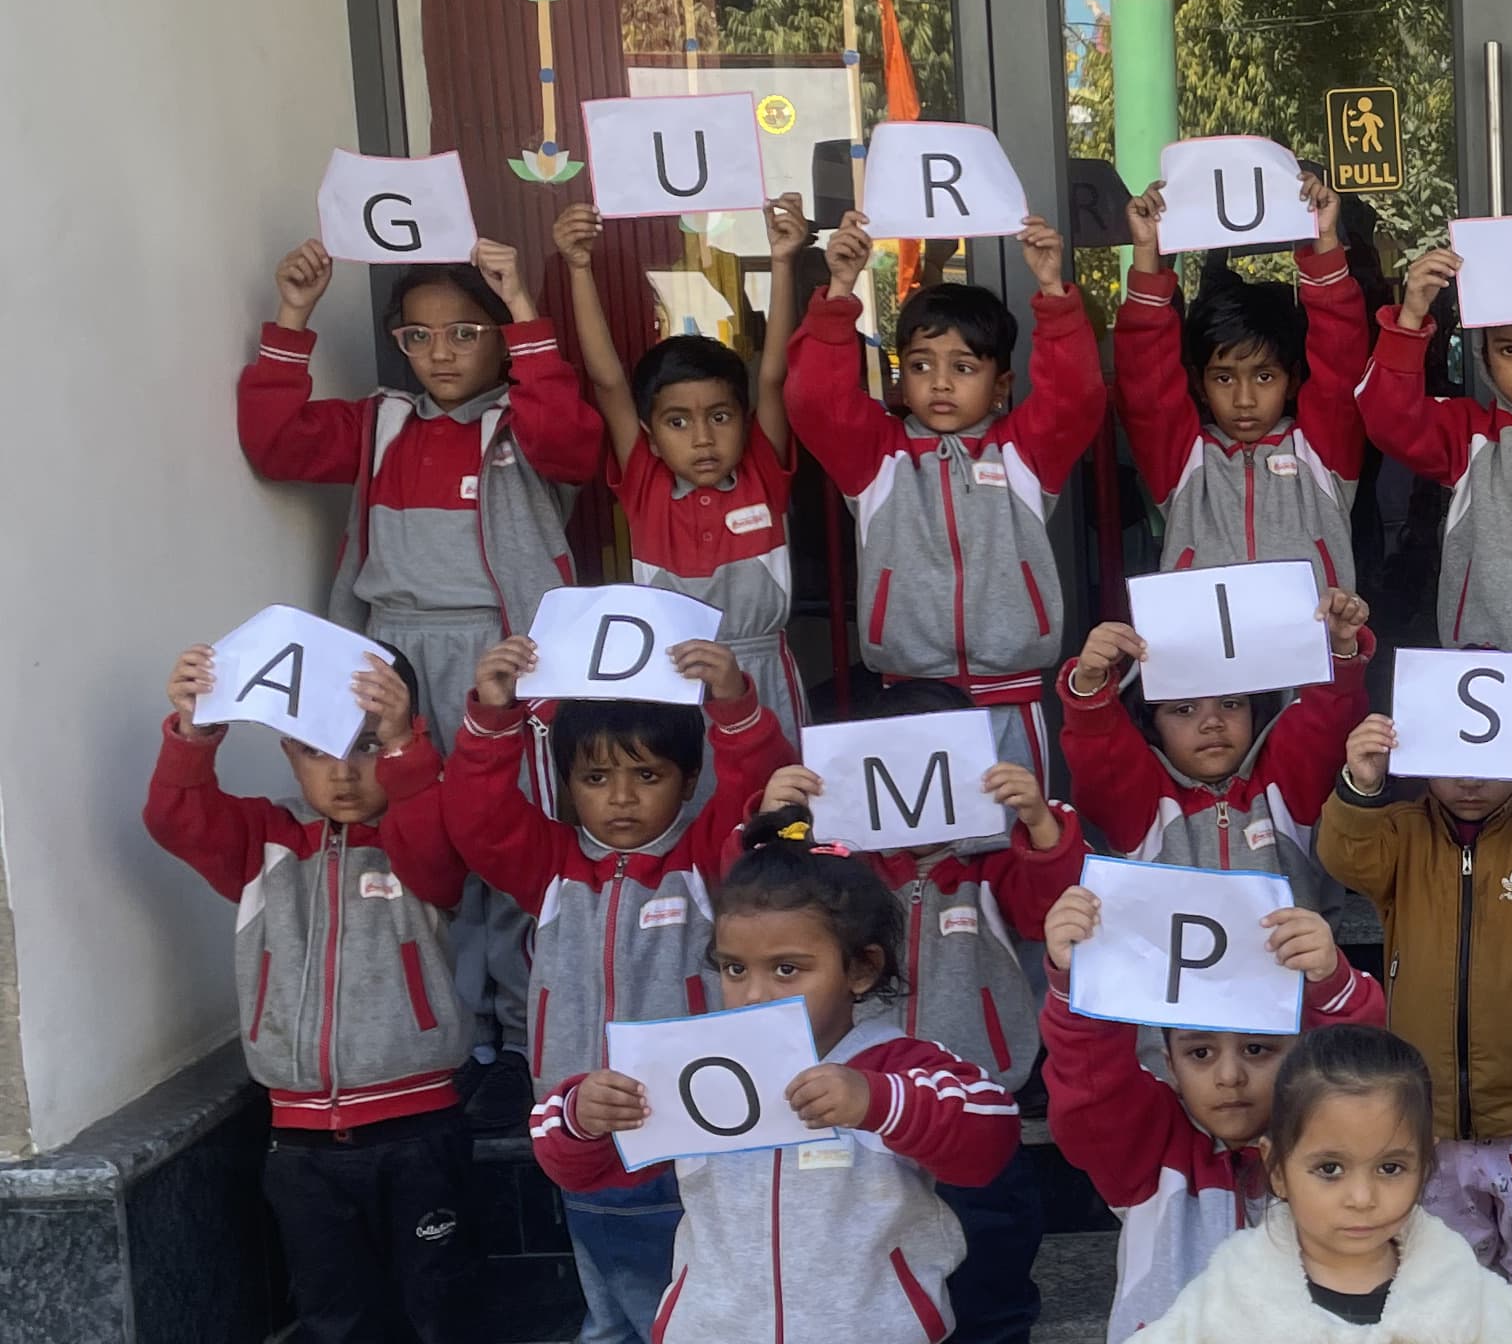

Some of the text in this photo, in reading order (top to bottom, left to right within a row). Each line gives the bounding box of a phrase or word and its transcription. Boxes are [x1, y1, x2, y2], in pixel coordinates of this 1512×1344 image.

[654, 131, 707, 197] U
[922, 154, 969, 217] R
[1214, 167, 1264, 231] U
[1340, 163, 1396, 184] PULL
[363, 193, 422, 252] G
[589, 615, 654, 680] D
[1216, 584, 1235, 658] I
[237, 643, 304, 717] A
[1458, 668, 1504, 743] S
[864, 751, 955, 831] M
[1167, 913, 1227, 1003] P
[679, 1057, 760, 1136] O
